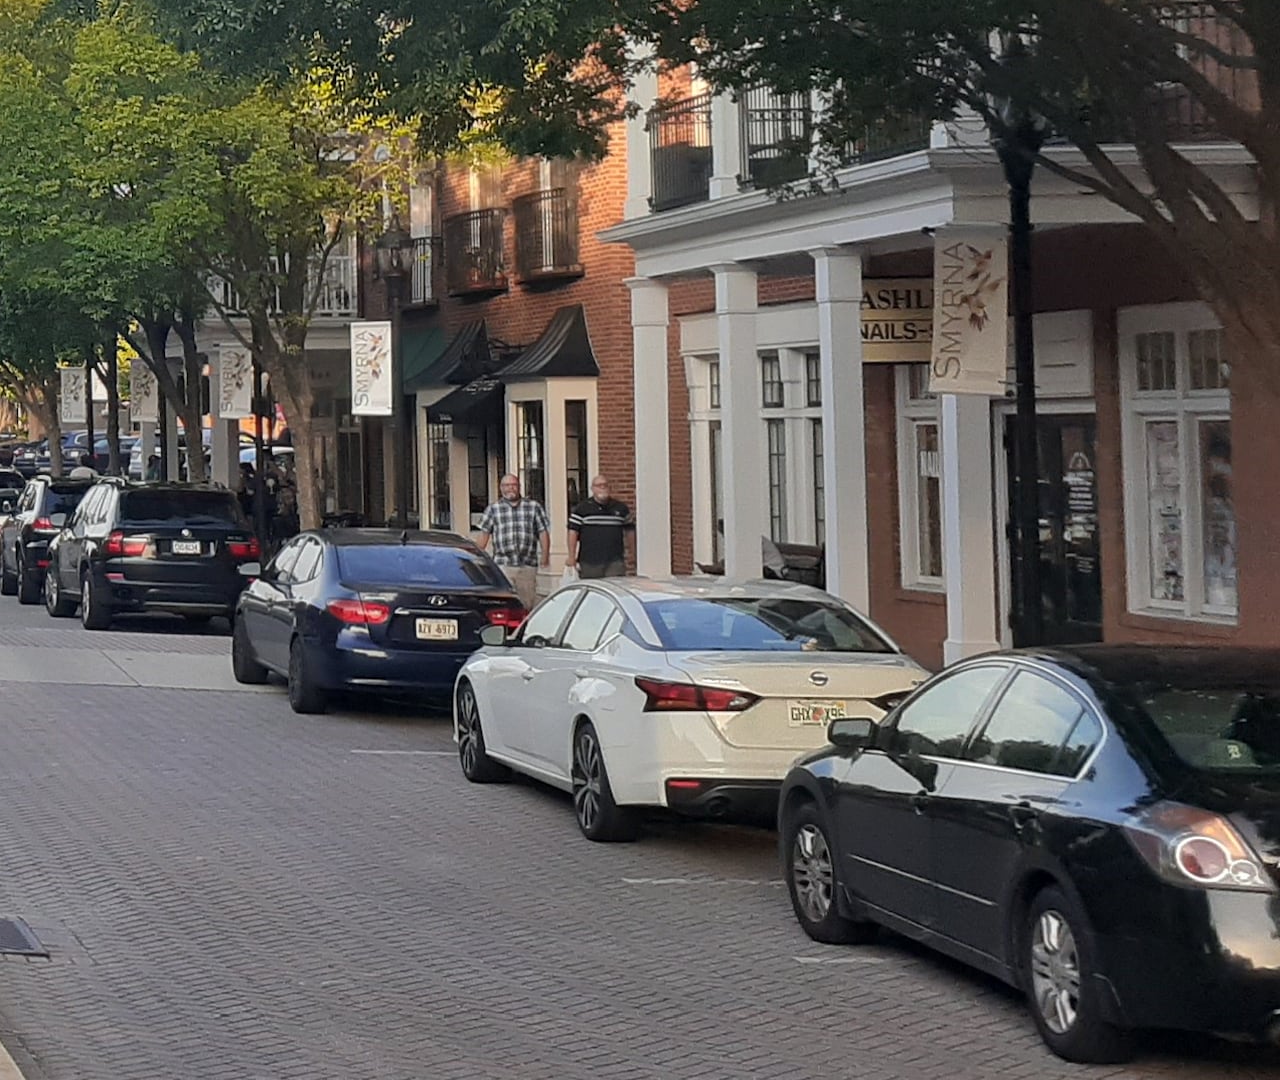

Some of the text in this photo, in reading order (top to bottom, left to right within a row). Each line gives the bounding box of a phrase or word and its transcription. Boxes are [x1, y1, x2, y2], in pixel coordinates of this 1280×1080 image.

[860, 288, 934, 310] ASHL
[933, 241, 965, 380] SMYRNA
[354, 329, 371, 408] SMYRNA
